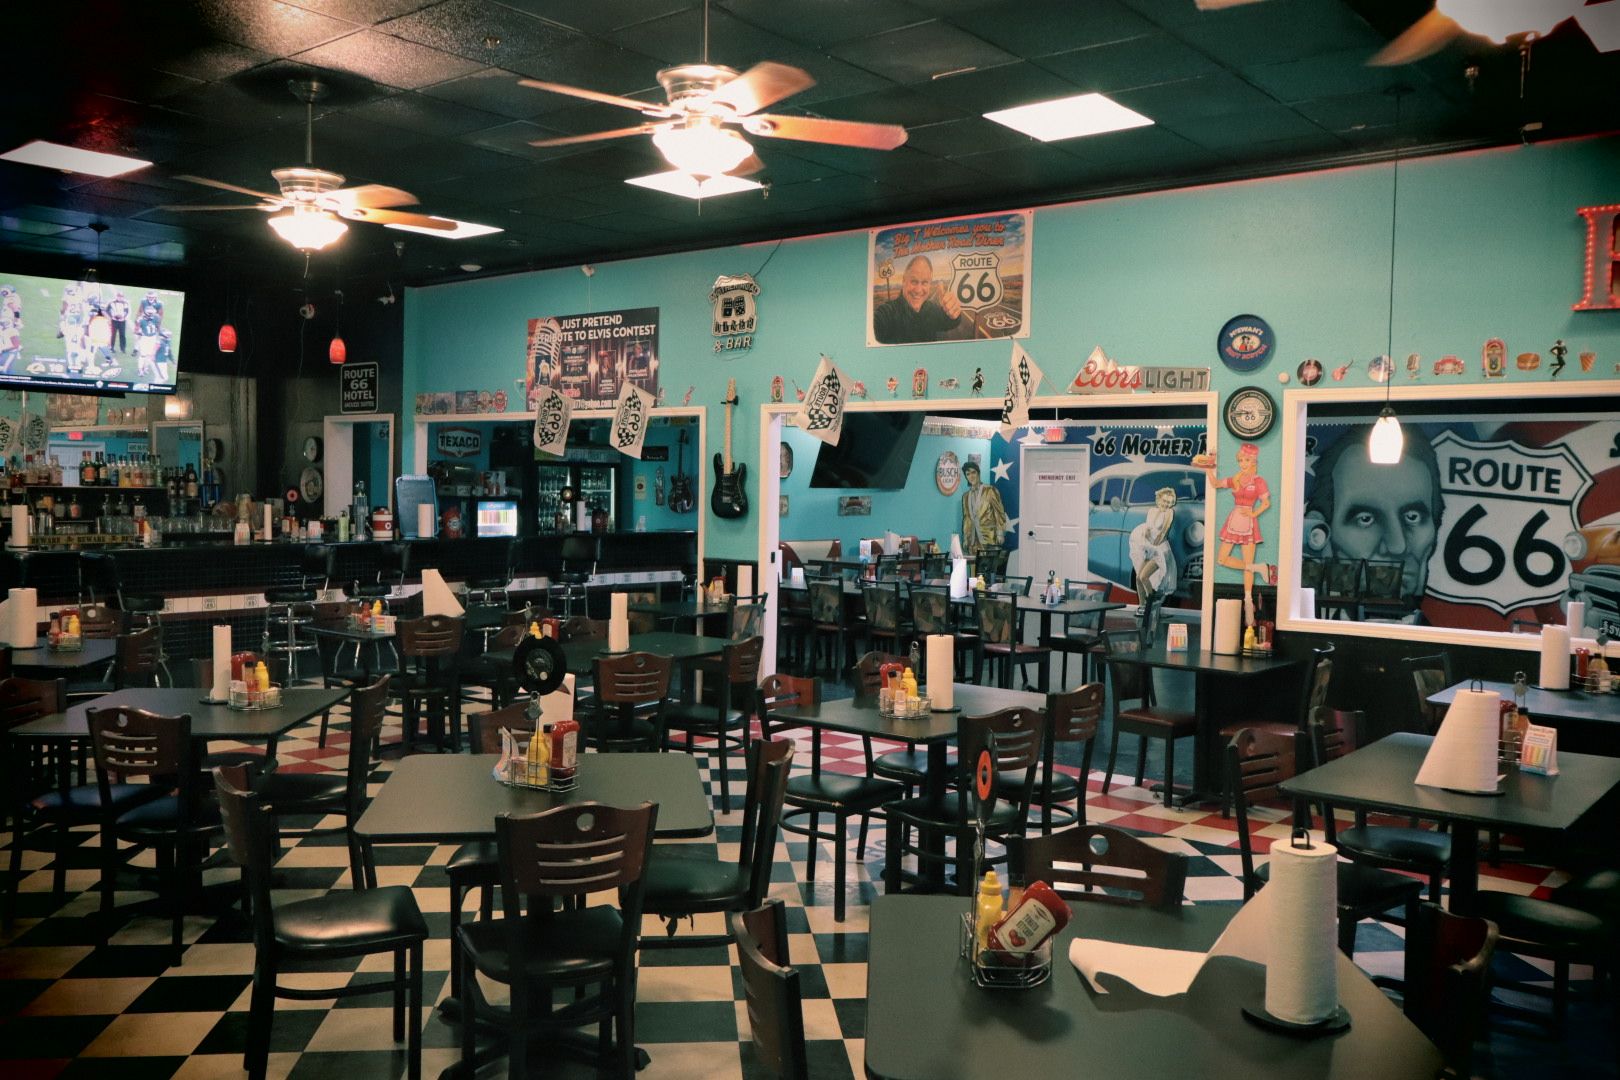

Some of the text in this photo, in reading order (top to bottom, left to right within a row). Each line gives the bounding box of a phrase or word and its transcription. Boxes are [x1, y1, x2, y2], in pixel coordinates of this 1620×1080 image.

[914, 229, 921, 241] T
[973, 225, 993, 236] you
[894, 233, 1005, 259] The Mother Road Diner
[959, 257, 993, 268] ROUTE
[957, 271, 996, 304] 66
[561, 314, 623, 330] JUST PRETEND
[993, 314, 1015, 327] 66
[574, 330, 587, 341] TO
[588, 327, 611, 339] ELVIS
[612, 324, 656, 338] CONTEST
[726, 335, 752, 350] BAR
[344, 367, 375, 379] ROUTE
[1074, 359, 1207, 389] Coors LIGHT
[350, 378, 368, 390] 66
[344, 389, 375, 401] HOTEL
[439, 435, 479, 448] TEXACO
[1094, 436, 1116, 456] 66
[939, 467, 959, 478] BUSCH
[1448, 456, 1563, 494] ROUTE
[1443, 503, 1566, 588] 66
